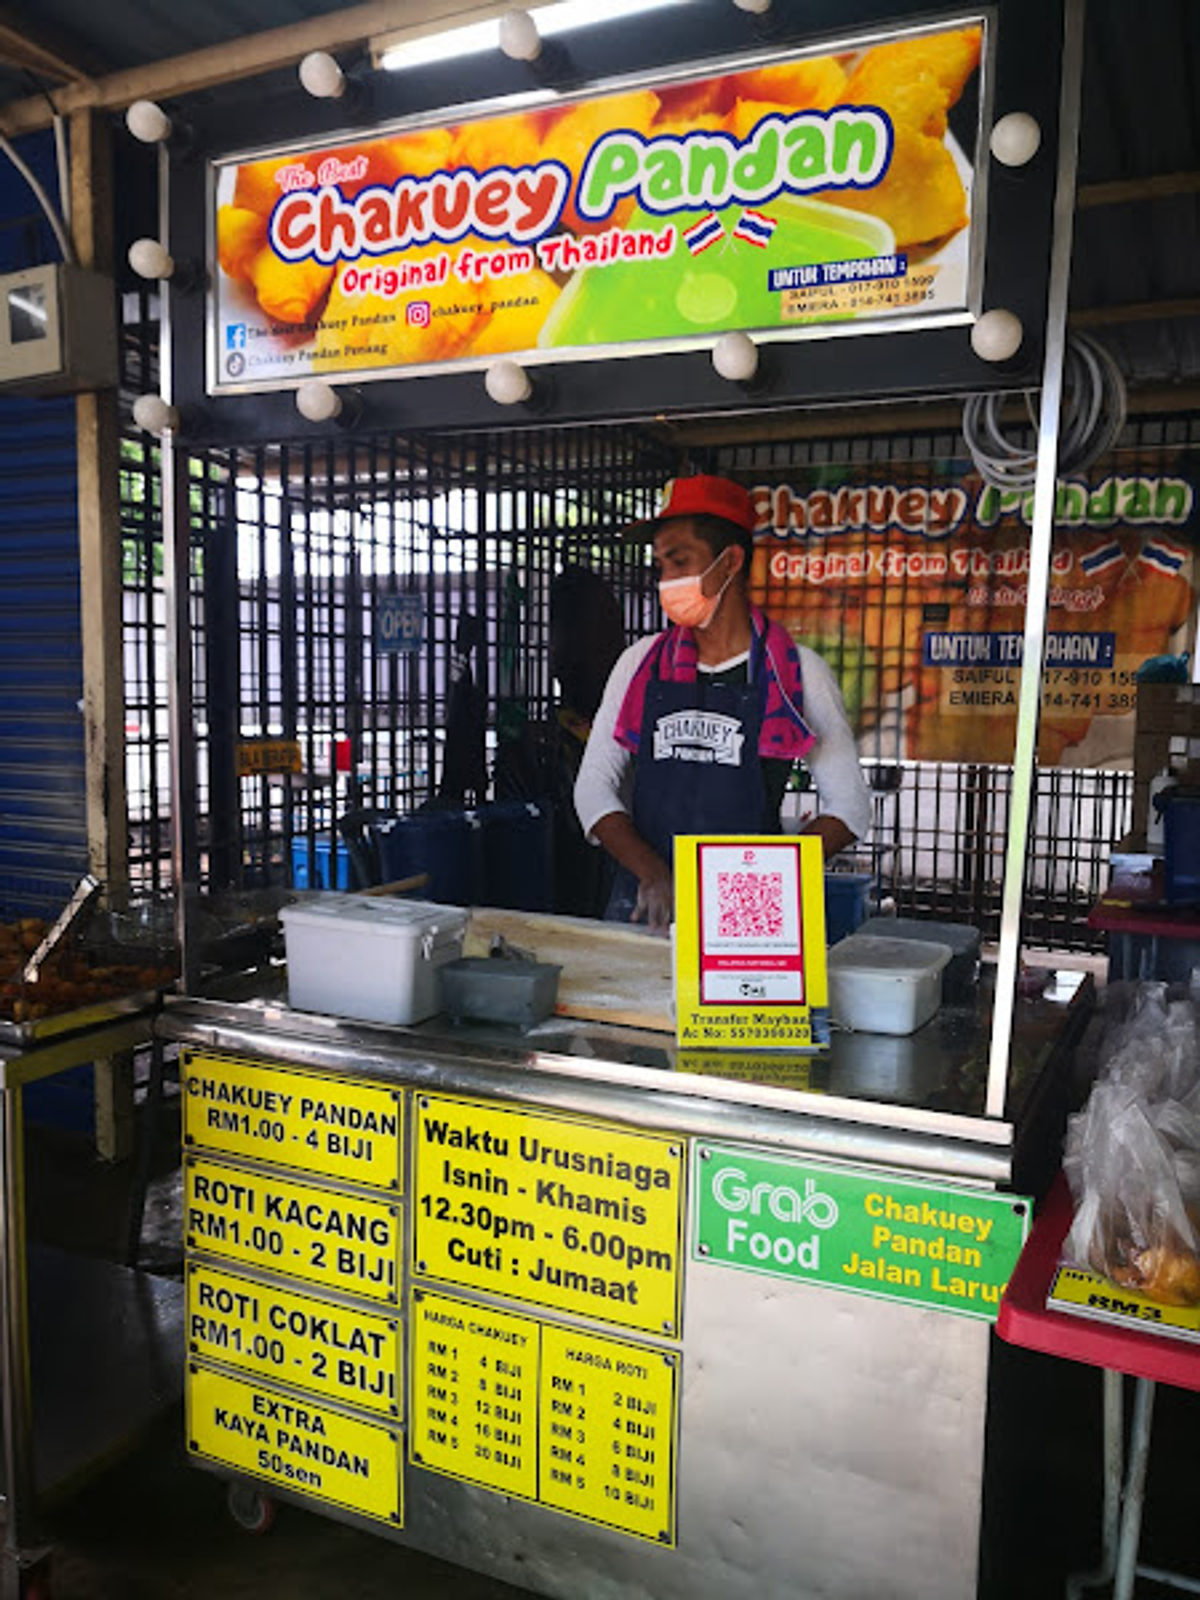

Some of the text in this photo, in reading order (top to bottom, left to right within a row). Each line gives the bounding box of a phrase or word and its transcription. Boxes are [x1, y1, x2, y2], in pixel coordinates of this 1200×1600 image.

[273, 110, 888, 259] Chakuey Pandan
[276, 155, 368, 192] The Best
[342, 229, 673, 295] Original from Thailand
[773, 266, 817, 287] UNTUK
[823, 256, 896, 282] TEMPAHAN
[352, 313, 396, 326] Pandan
[300, 346, 340, 361] Pandan
[344, 344, 388, 357] Penang
[771, 547, 1072, 583] Original from Thaild
[931, 634, 991, 660] UNTUK
[953, 669, 1015, 685] SAIFUL
[1044, 670, 1102, 686] 17-910
[949, 690, 1015, 706] EMIERA
[1044, 692, 1101, 708] 14-741
[663, 719, 732, 743] CHAKUEY
[683, 1027, 698, 1039] Ac
[690, 1013, 810, 1027] Transfer Mayban
[187, 1077, 396, 1137] CHAKUEY PANDAN
[208, 1108, 284, 1142] RM1.00
[306, 1129, 319, 1149] 4
[328, 1133, 372, 1161] BIJI
[424, 1118, 671, 1191] Waktu Urusniaga
[194, 1176, 389, 1246] ROTI KACANG
[443, 1161, 508, 1196] Isnin
[536, 1179, 647, 1225] Khamis
[712, 1167, 839, 1229] Grab
[421, 1195, 535, 1241] 12.30pm
[563, 1226, 672, 1271] 6.00pm
[864, 1193, 993, 1242] Chakuey
[189, 1208, 283, 1255] RM1.00
[310, 1242, 326, 1268] 2
[338, 1248, 394, 1286] BIJI
[728, 1218, 820, 1270] Food
[873, 1225, 982, 1268] Pandan
[448, 1237, 501, 1271] Cuti
[528, 1259, 638, 1305] Jumaat
[842, 1253, 921, 1287] Jalan
[199, 1282, 386, 1358] ROTI COKLAT
[424, 1310, 528, 1347] HARGA CHAKUEY
[191, 1315, 284, 1364] RM1.00
[312, 1352, 327, 1378] 2
[339, 1360, 394, 1398] BIJI
[428, 1340, 521, 1378] RM 1 4 BIJI
[566, 1348, 648, 1380] HARGA ROTI
[428, 1363, 521, 1401] RM 2 8 BIJI
[551, 1376, 657, 1415] RM 1 2 BIJI
[253, 1395, 326, 1436] EXTRA
[428, 1385, 521, 1425] RM 3 12 BIJI
[551, 1400, 655, 1440] RM 2 4 BIJI
[215, 1407, 369, 1478] KAYA PANDAN
[428, 1407, 521, 1447] RM 4 16 BIJI
[551, 1423, 655, 1464] RM 3 6 BIJI
[258, 1450, 322, 1488] 50sen
[428, 1429, 521, 1470] RM 5 20 BIJI
[551, 1445, 654, 1488] RM 4 8 BIJI
[550, 1468, 654, 1511] RM 5 10 BIJI
